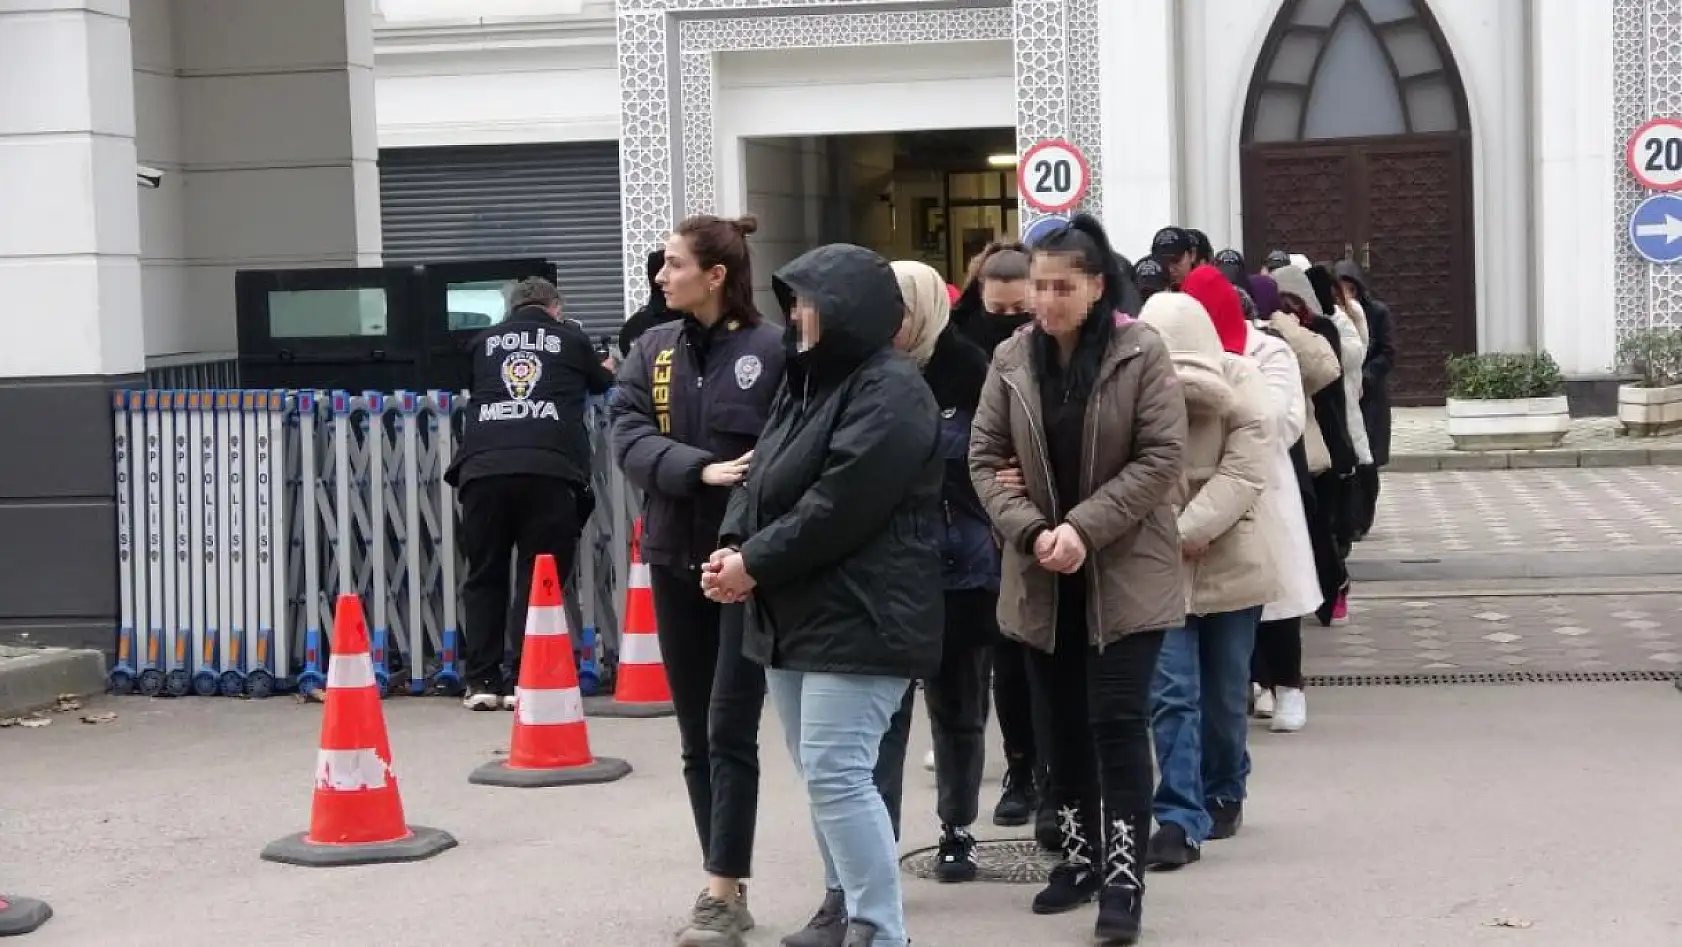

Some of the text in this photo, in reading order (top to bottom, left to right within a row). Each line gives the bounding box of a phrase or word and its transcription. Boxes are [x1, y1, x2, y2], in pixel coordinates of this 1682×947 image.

[1645, 137, 1682, 171] 20
[1034, 159, 1071, 193] 20
[485, 328, 562, 356] POLİS
[478, 400, 560, 422] MEDYA
